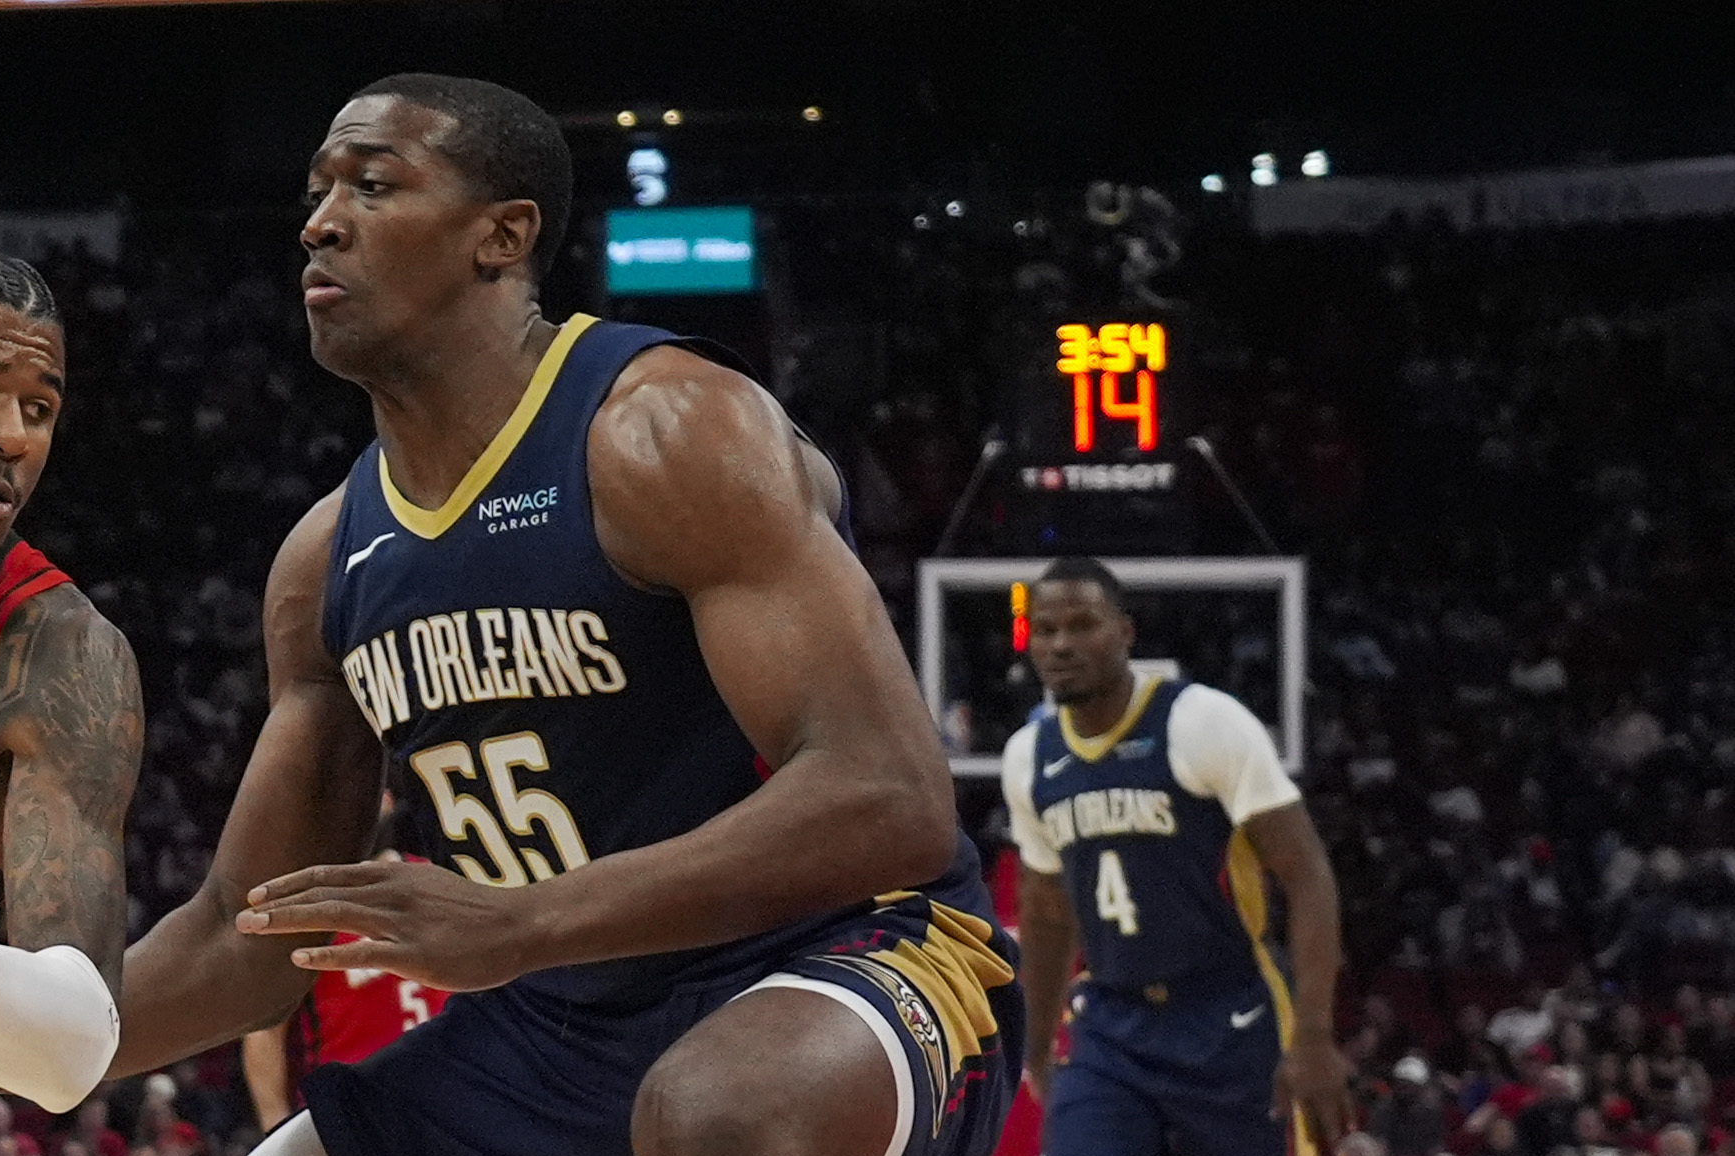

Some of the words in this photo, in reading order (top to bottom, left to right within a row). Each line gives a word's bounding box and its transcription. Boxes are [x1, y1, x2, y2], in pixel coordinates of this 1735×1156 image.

[1056, 323, 1166, 374] 3:54
[1073, 369, 1158, 453] 14
[487, 510, 549, 535] GARAGE
[408, 607, 628, 711] ORLEANS
[409, 729, 592, 889] 55
[1073, 787, 1177, 839] ORLEANS
[1095, 849, 1138, 936] 4
